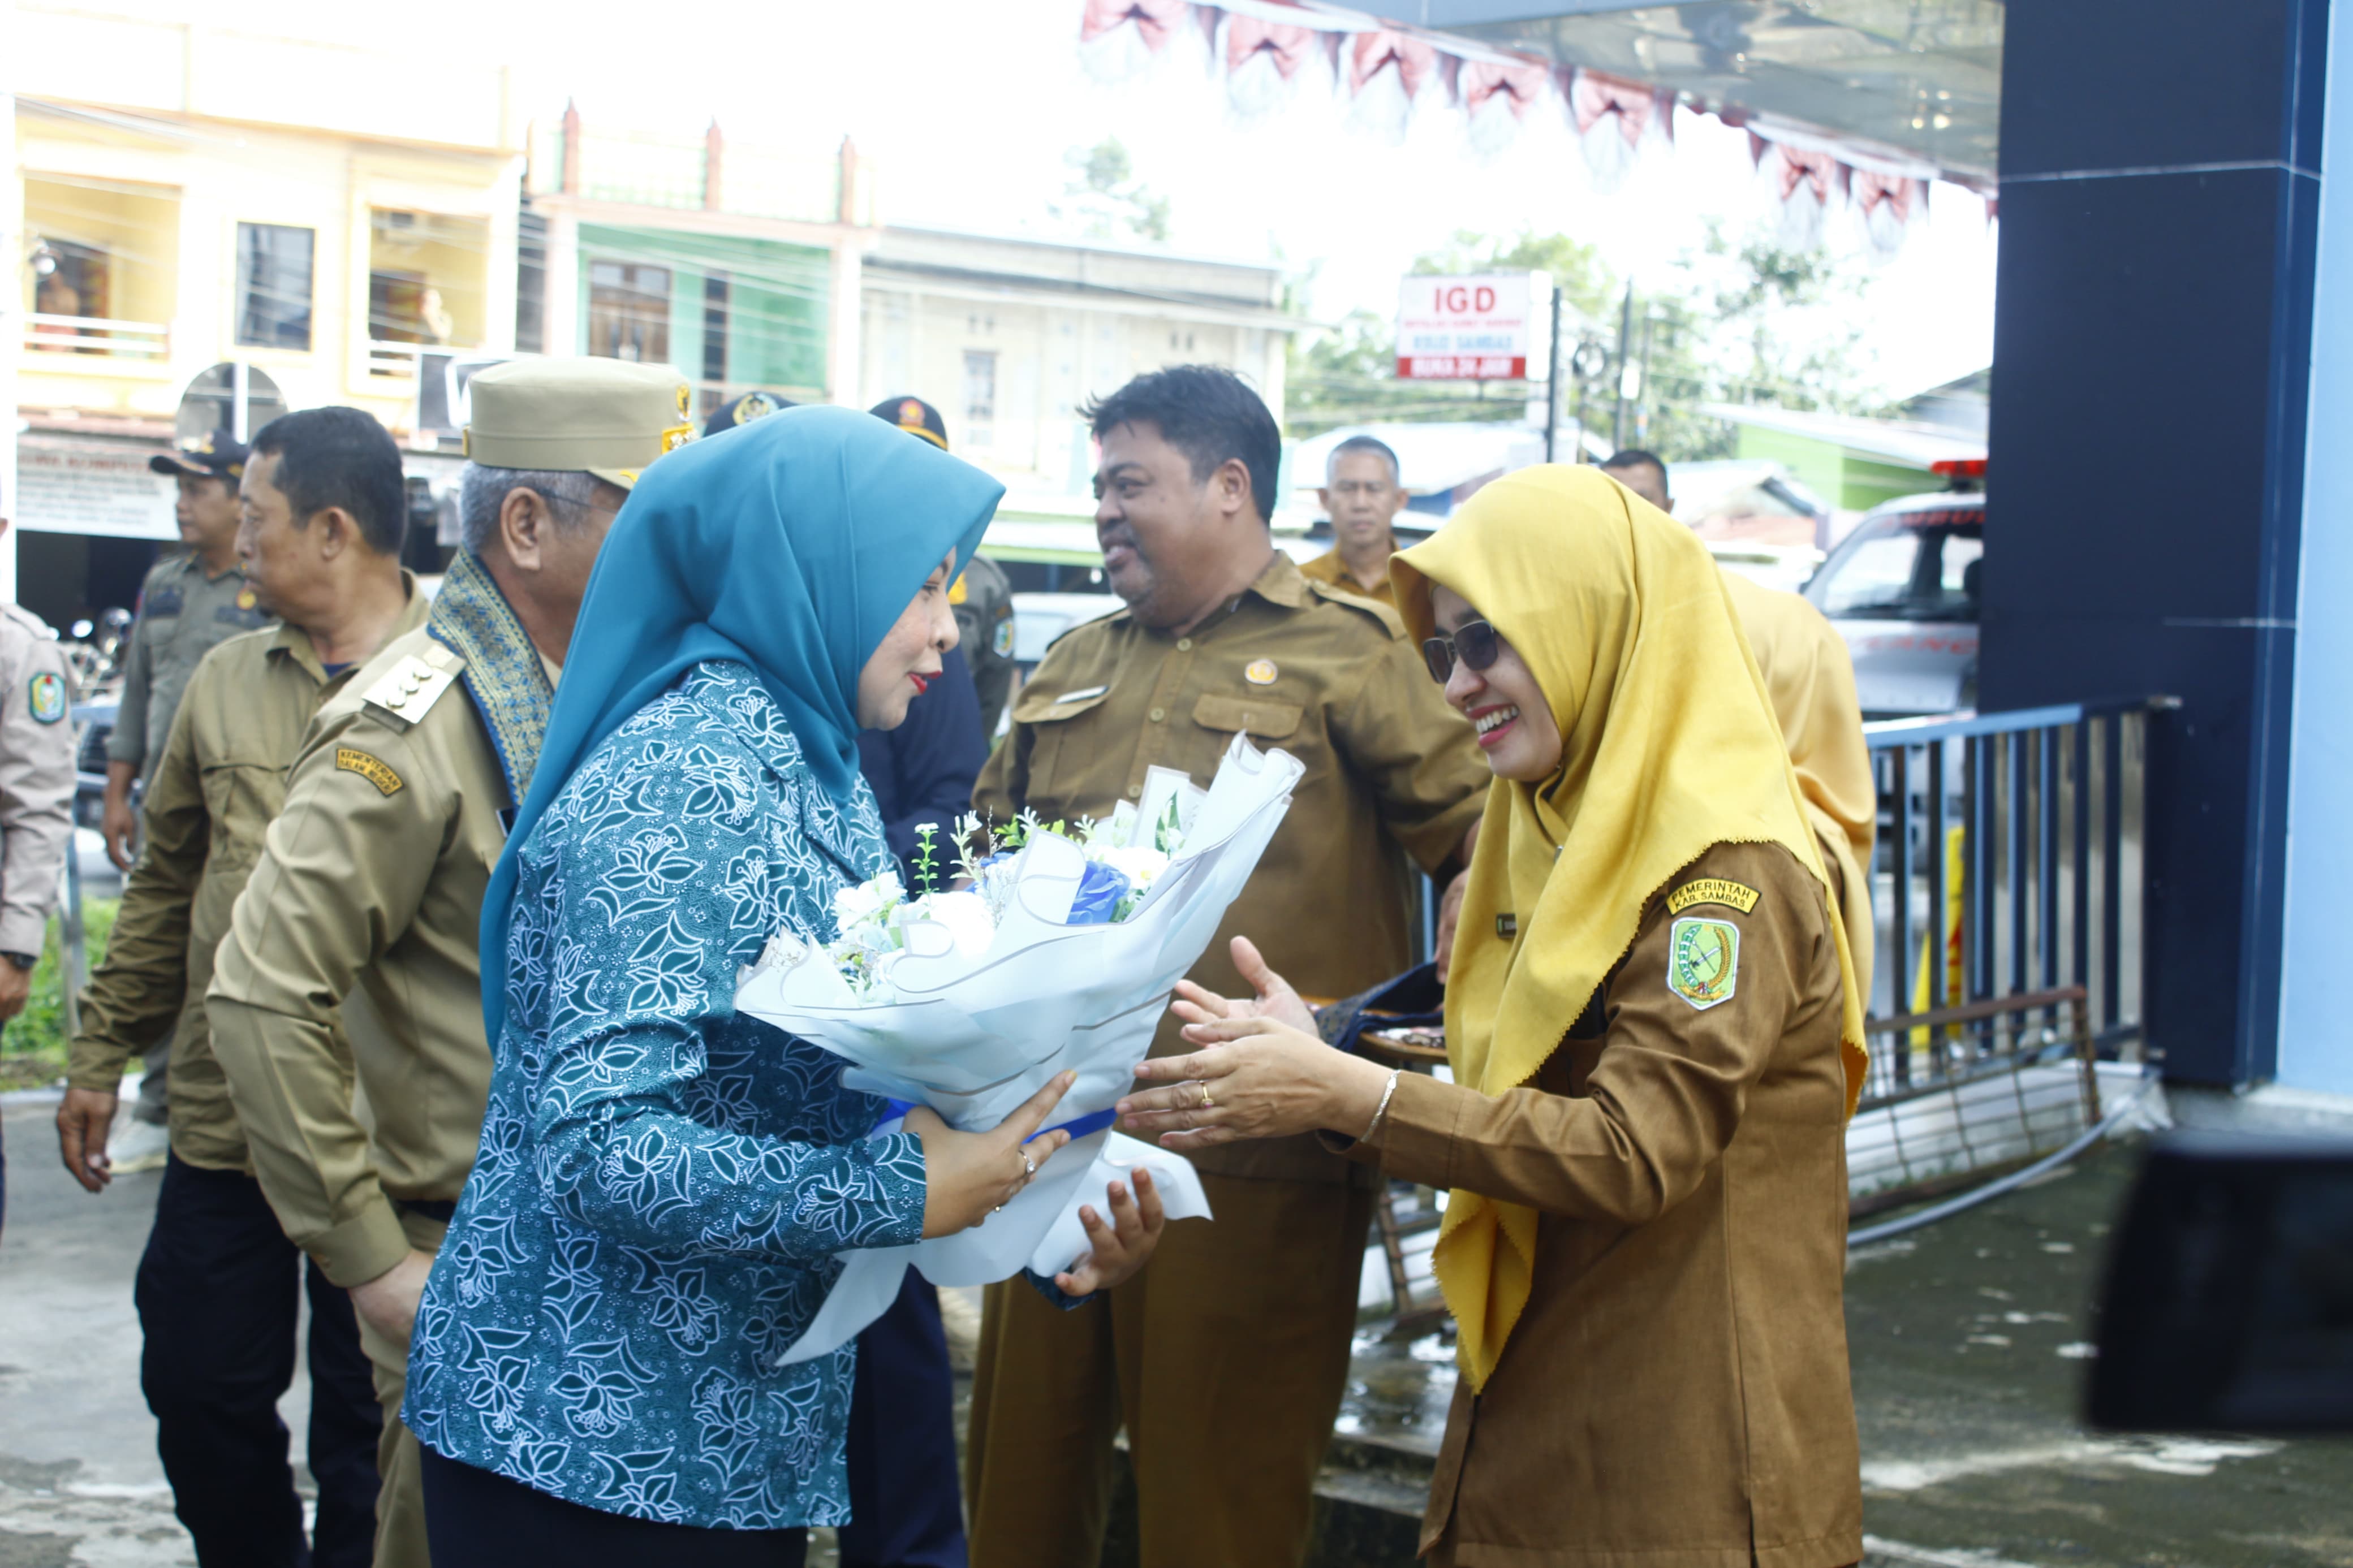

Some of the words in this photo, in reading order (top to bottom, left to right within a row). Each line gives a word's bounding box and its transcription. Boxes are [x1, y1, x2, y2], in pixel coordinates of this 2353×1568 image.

[1435, 286, 1496, 314] IGD
[1672, 882, 1750, 901] PEMERINTAH
[1675, 894, 1698, 910] KAB.
[1701, 892, 1746, 907] SAMBAS
